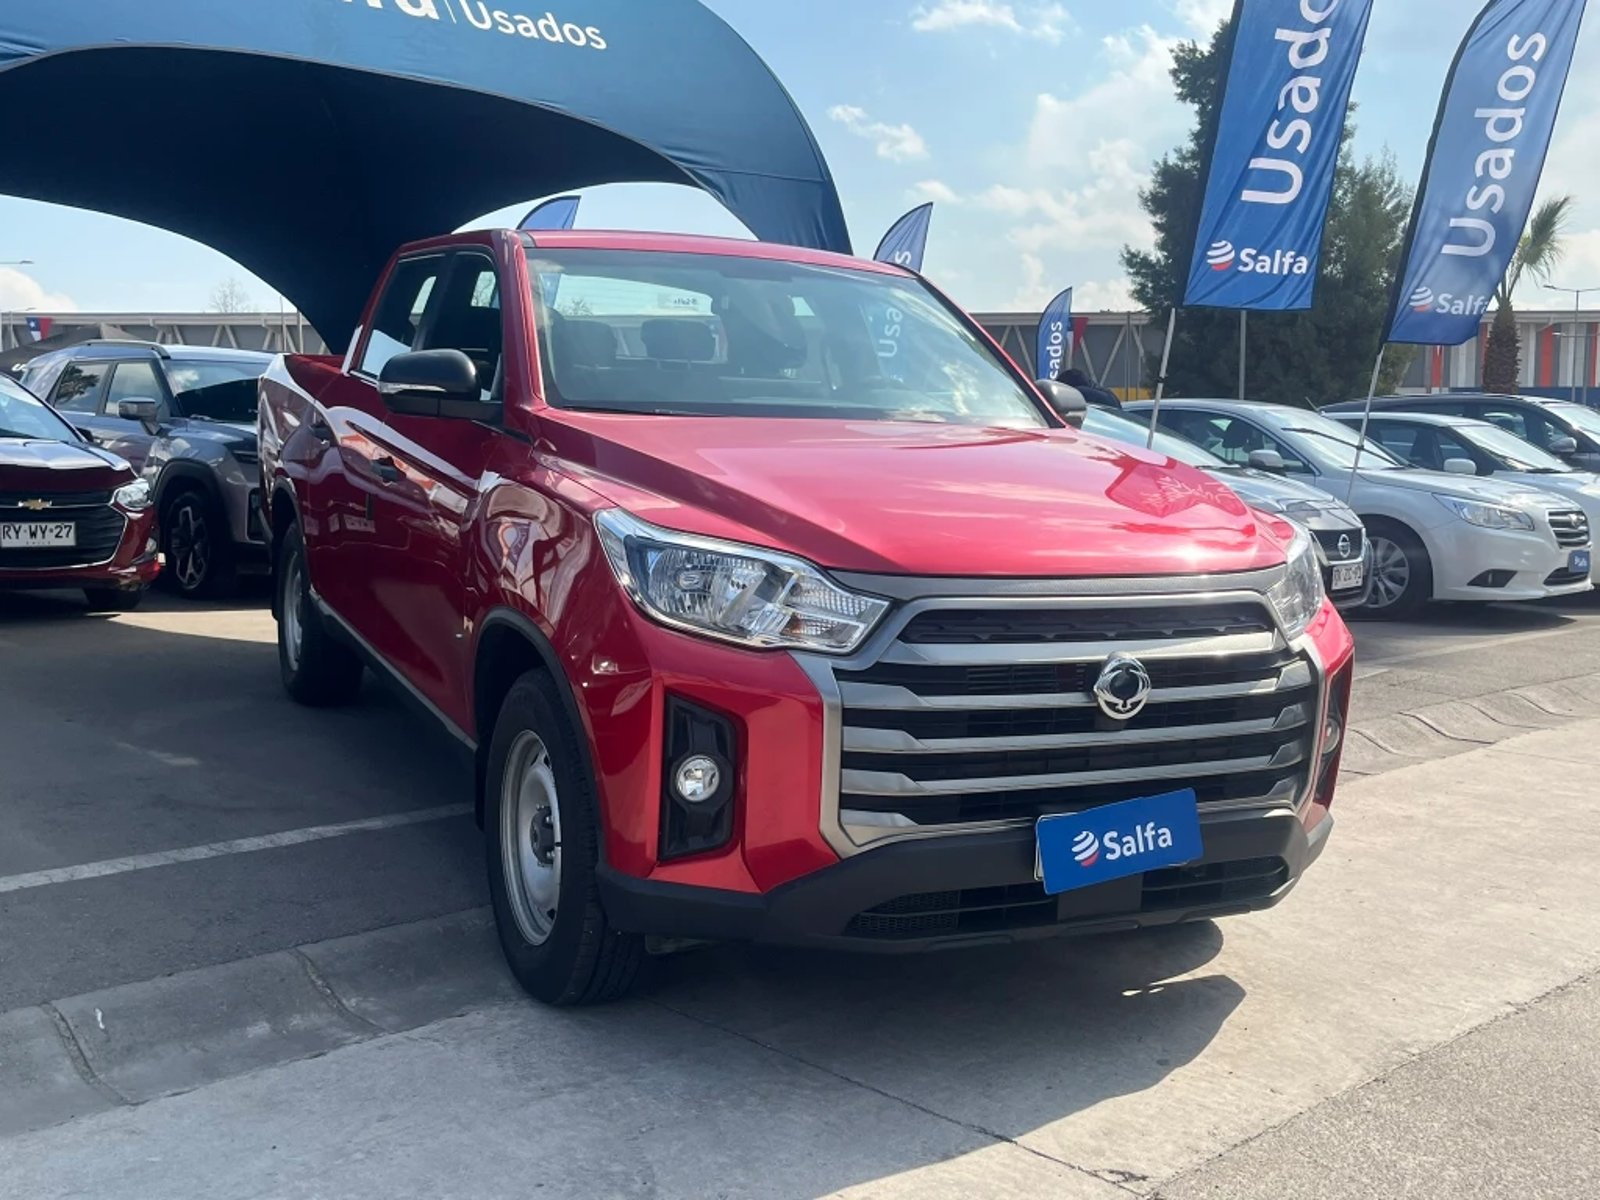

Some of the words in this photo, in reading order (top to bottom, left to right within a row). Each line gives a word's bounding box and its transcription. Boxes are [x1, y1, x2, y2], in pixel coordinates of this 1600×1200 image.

[458, 0, 607, 50] Usados
[1240, 0, 1339, 204] Usado
[1441, 32, 1547, 257] Usados
[1237, 247, 1309, 275] Salfa
[1046, 321, 1064, 379] sados
[1103, 821, 1173, 861] Salfa
